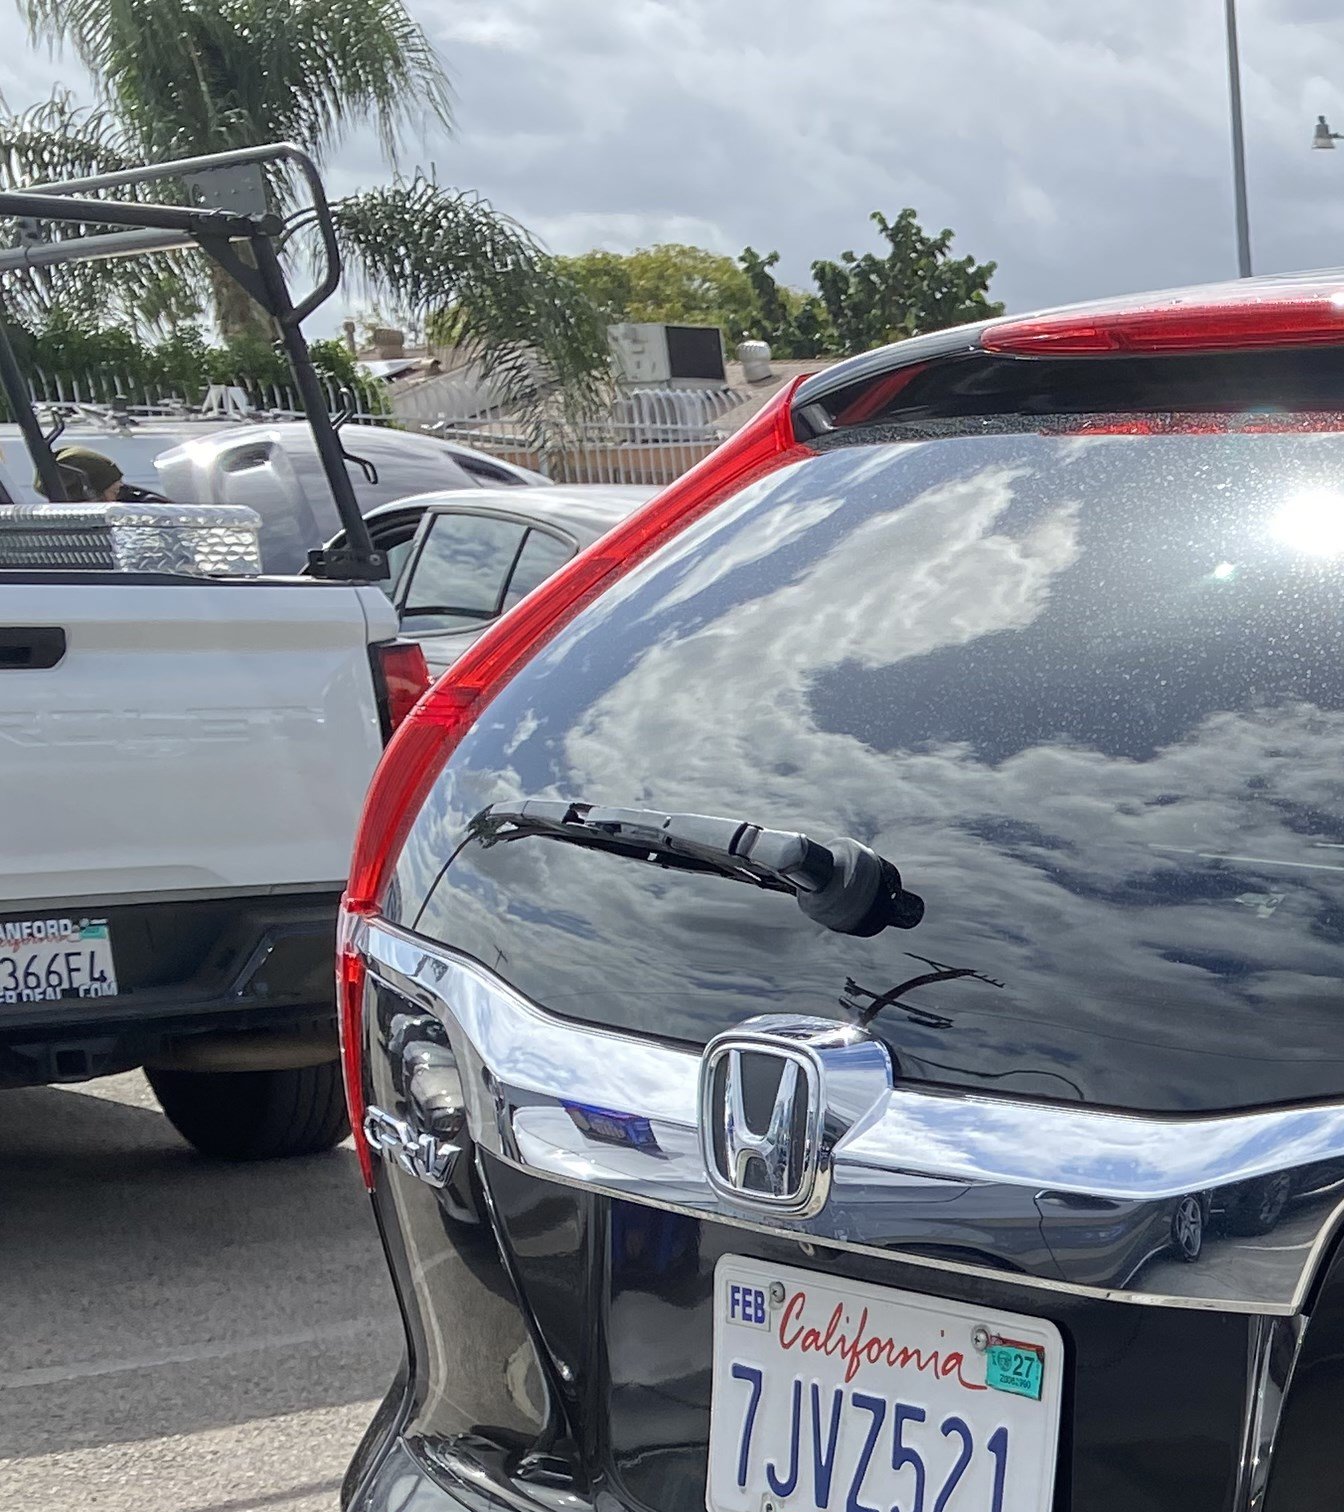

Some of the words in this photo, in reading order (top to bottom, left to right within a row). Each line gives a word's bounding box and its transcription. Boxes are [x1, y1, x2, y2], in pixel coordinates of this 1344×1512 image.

[730, 1284, 766, 1325] FEB
[779, 1291, 989, 1391] California
[1012, 1353, 1035, 1379] 27
